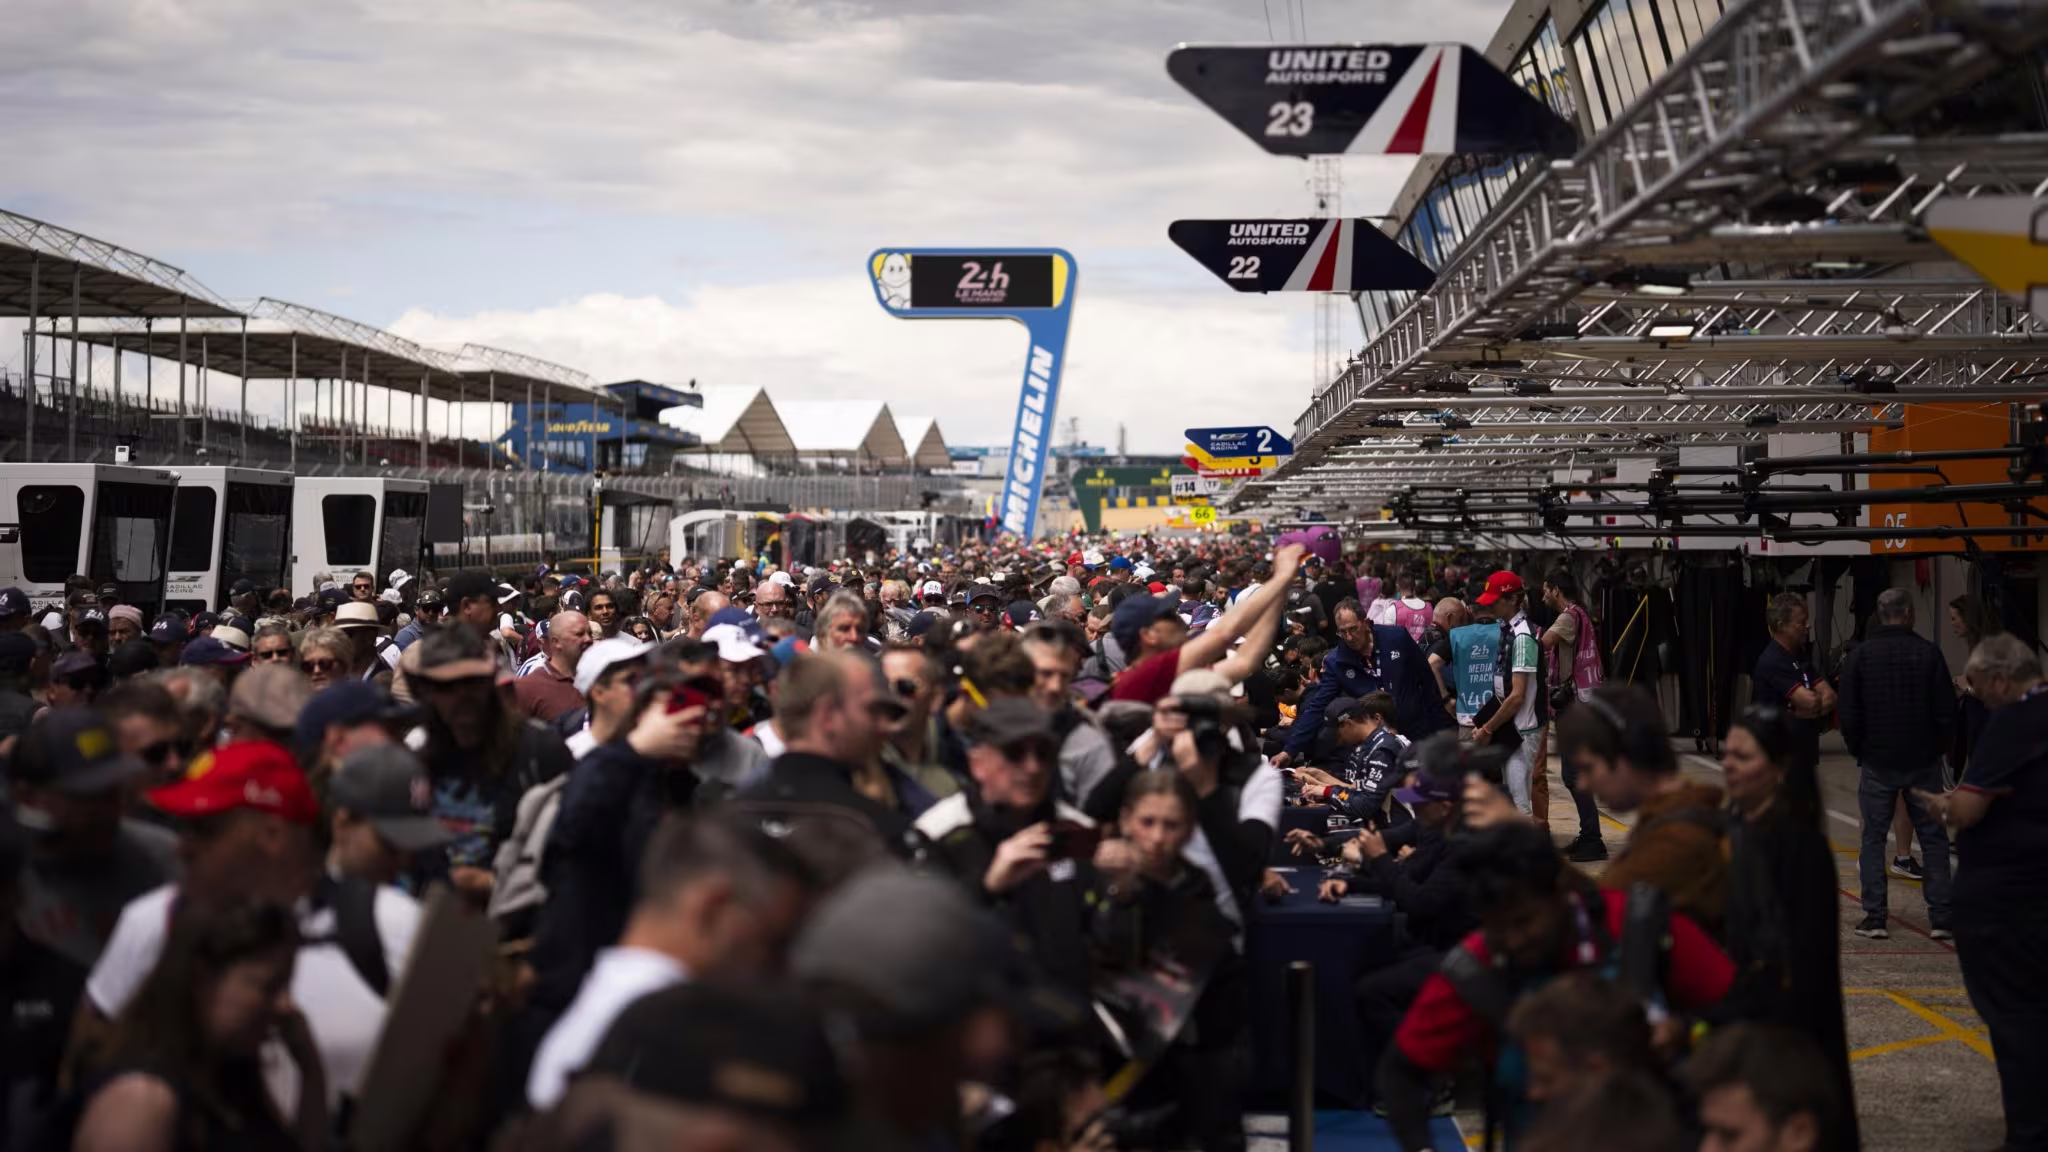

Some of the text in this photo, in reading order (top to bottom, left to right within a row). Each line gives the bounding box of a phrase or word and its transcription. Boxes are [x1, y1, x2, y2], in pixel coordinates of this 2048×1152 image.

[1268, 50, 1391, 70] UNITED
[1264, 71, 1387, 83] AUTOSPORTS
[1264, 101, 1314, 137] 23
[1229, 223, 1310, 236] UNITED
[1227, 237, 1307, 245] AUTOSPORTS
[1227, 255, 1261, 279] 22
[1004, 344, 1054, 534] MICHELIN
[1256, 428, 1273, 453] 2
[1175, 481, 1196, 492] #14
[1195, 507, 1211, 519] 66
[1468, 662, 1493, 674] MEDIA
[1469, 672, 1494, 684] TRACK
